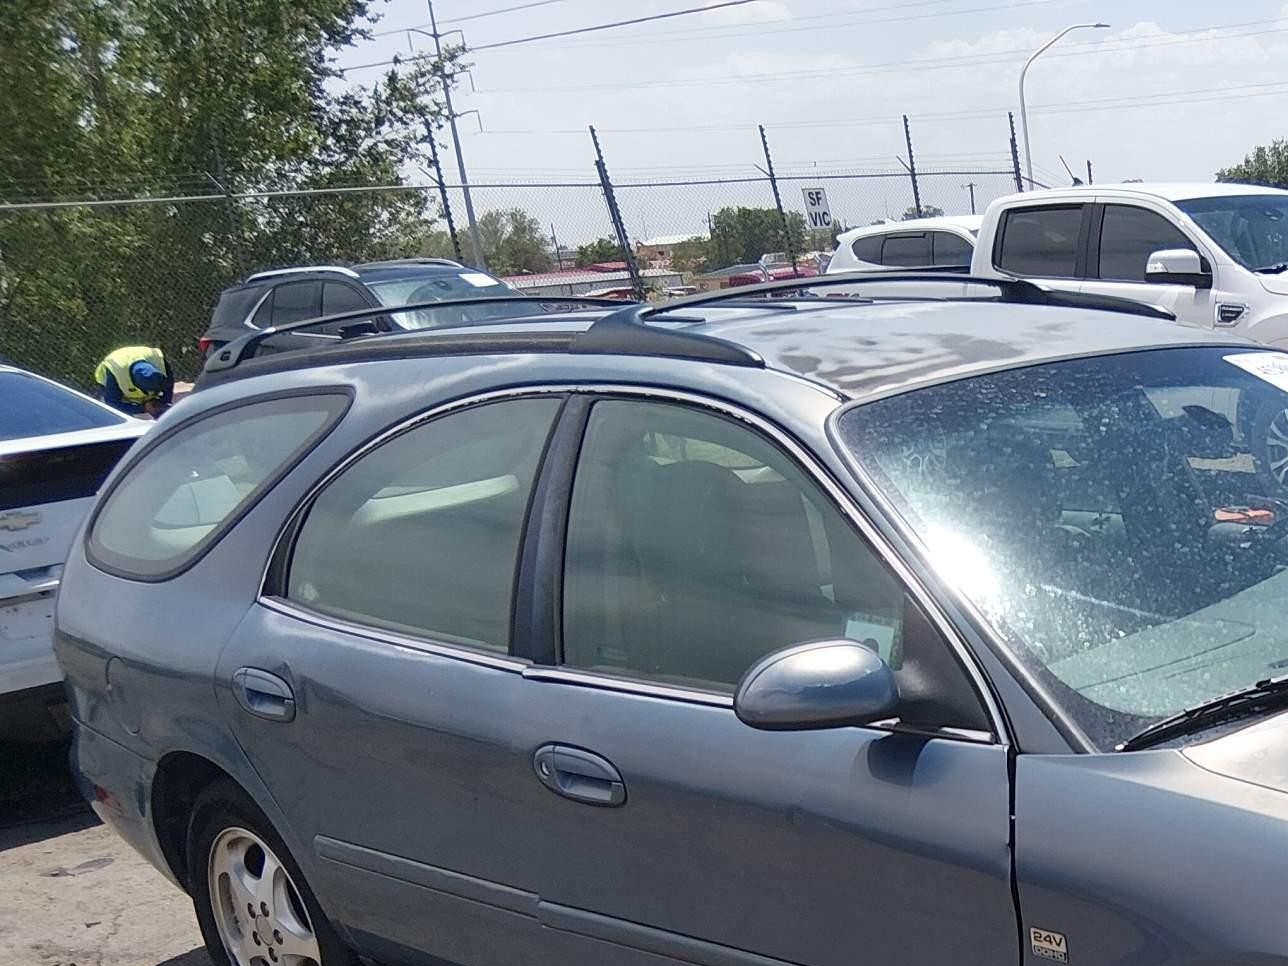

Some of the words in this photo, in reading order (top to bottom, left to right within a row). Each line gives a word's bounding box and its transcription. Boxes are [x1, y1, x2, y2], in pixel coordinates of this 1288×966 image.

[808, 191, 822, 206] SF
[809, 211, 831, 227] VIC
[1033, 931, 1063, 947] 24V
